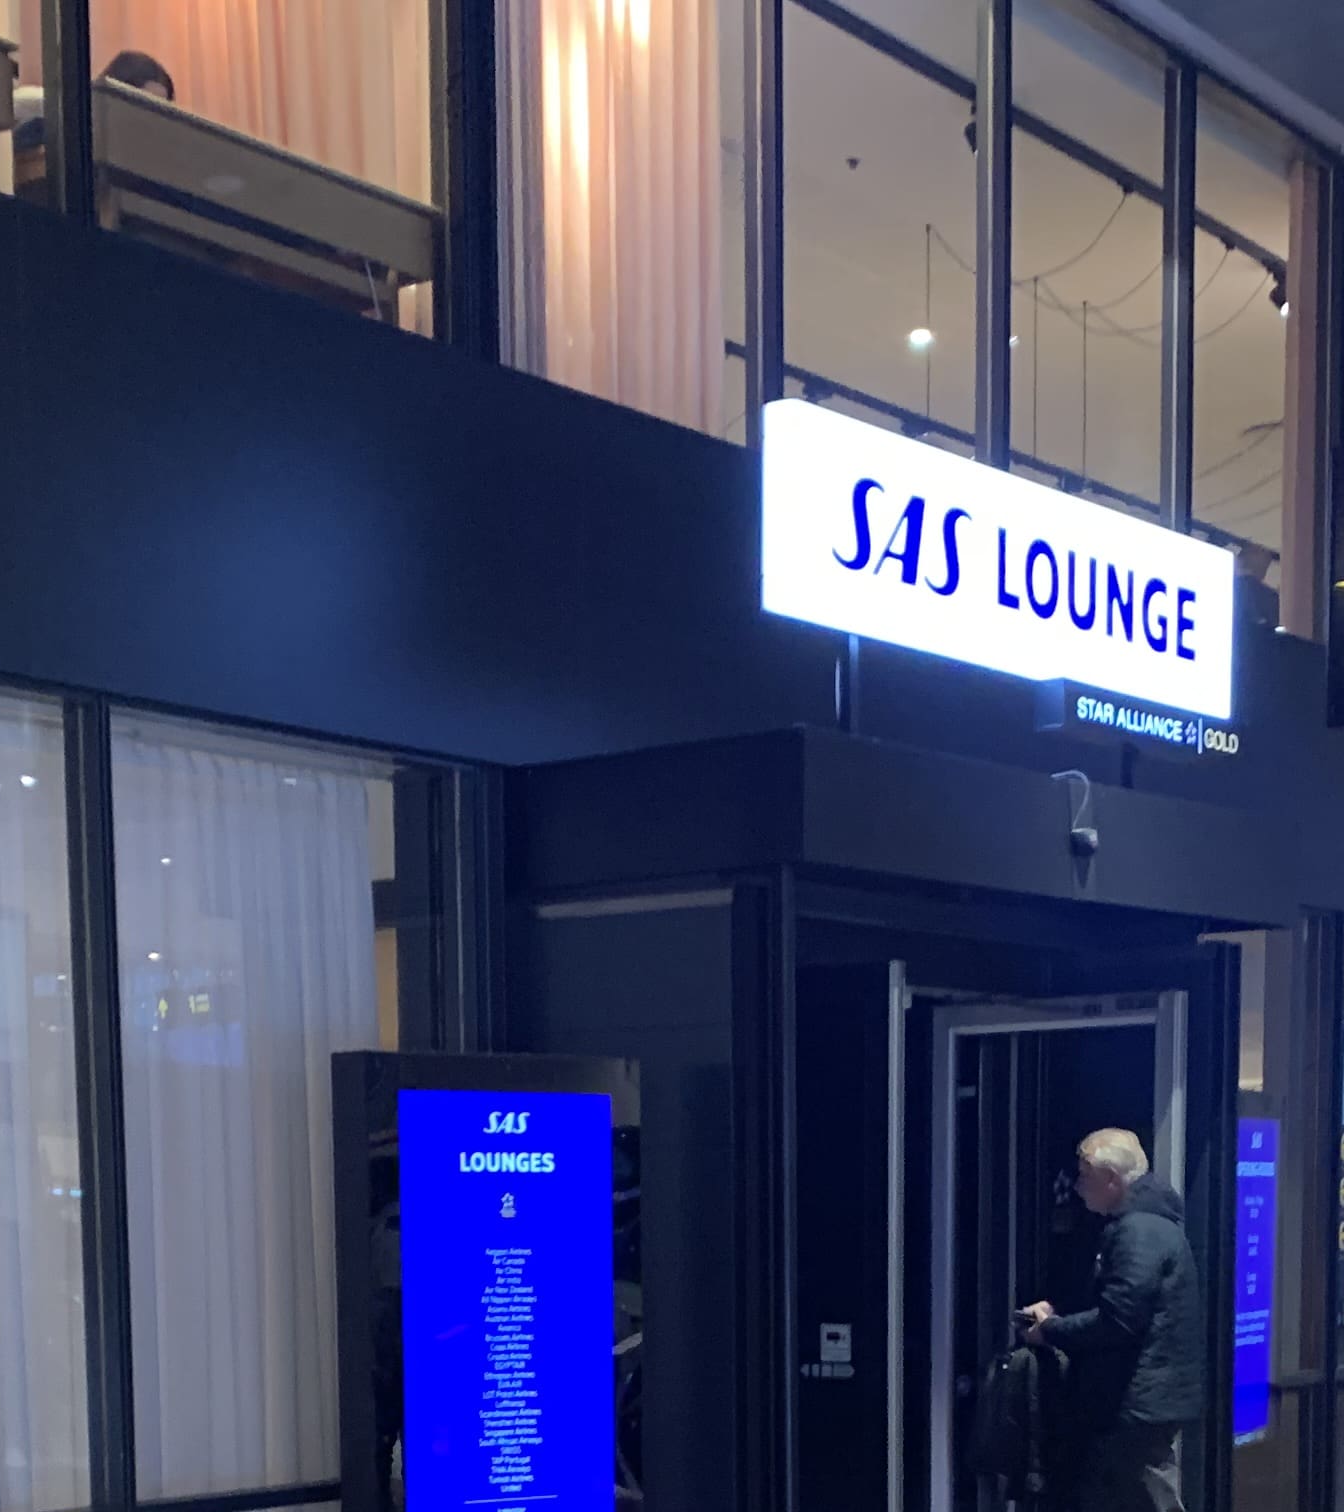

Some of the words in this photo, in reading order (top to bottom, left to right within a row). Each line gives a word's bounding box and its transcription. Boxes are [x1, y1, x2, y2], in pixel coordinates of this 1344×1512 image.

[832, 478, 972, 596] SAS
[997, 527, 1197, 661] LOUNGE
[1077, 695, 1114, 726] STAR
[1116, 706, 1183, 743] ALLIANCE
[1204, 728, 1239, 754] GOLD
[483, 1111, 531, 1134] SAS
[459, 1151, 555, 1173] LOUNGES
